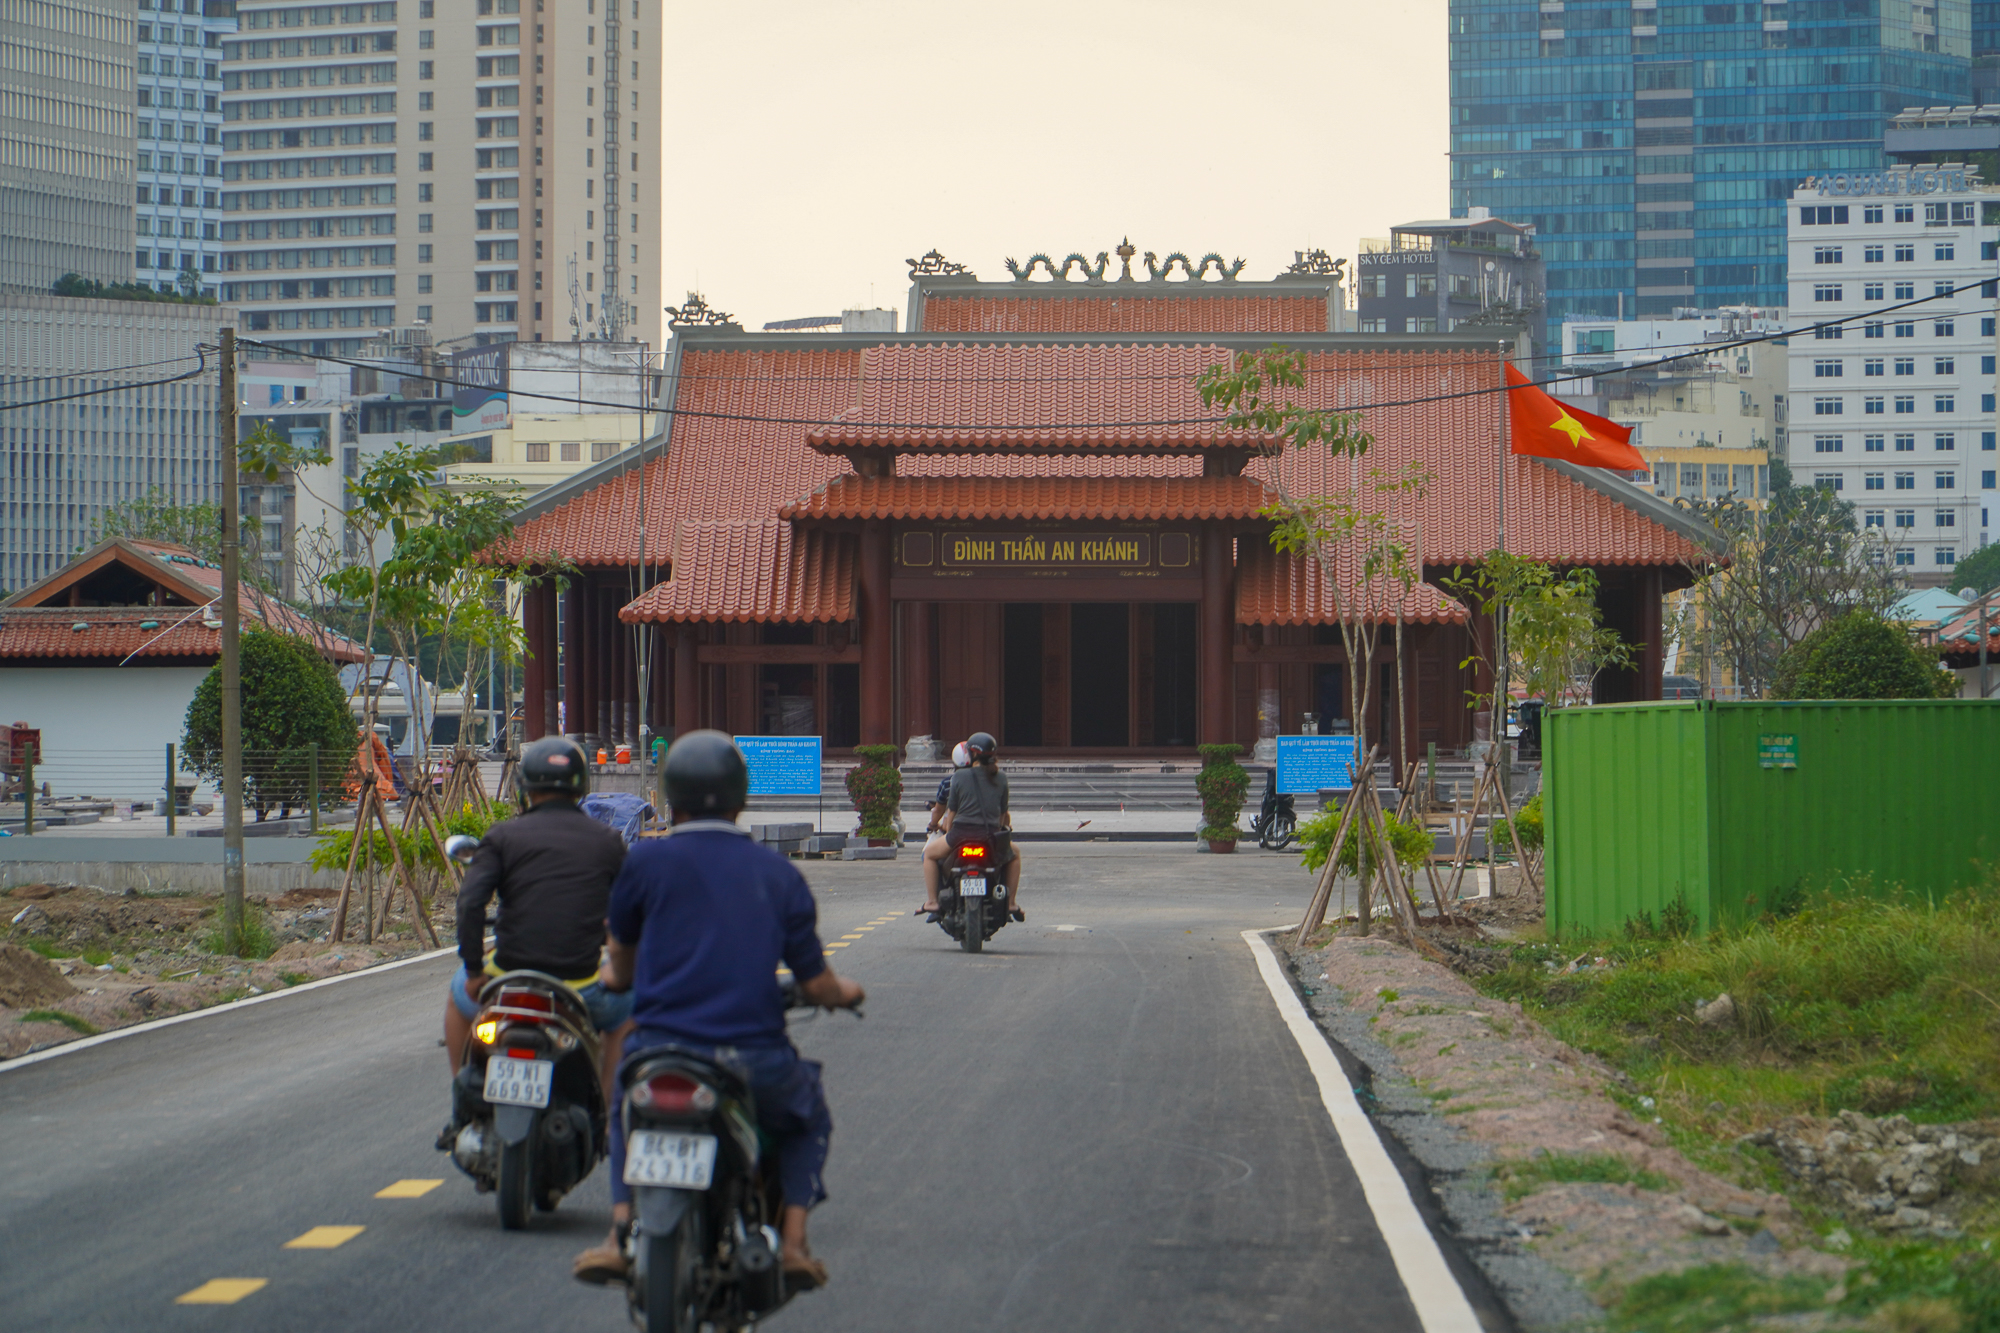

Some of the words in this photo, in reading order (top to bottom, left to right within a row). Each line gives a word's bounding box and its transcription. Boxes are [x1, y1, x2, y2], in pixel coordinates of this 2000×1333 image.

[1818, 172, 1899, 197] AQUARI
[1906, 170, 1969, 194] HOTEL
[1402, 253, 1436, 265] HOTEL
[457, 351, 500, 392] HYOSUNG
[954, 536, 995, 561] ĐÌNH
[1001, 534, 1046, 561] THẦN
[1051, 541, 1075, 561] AN
[1081, 536, 1139, 561] KHÁNH
